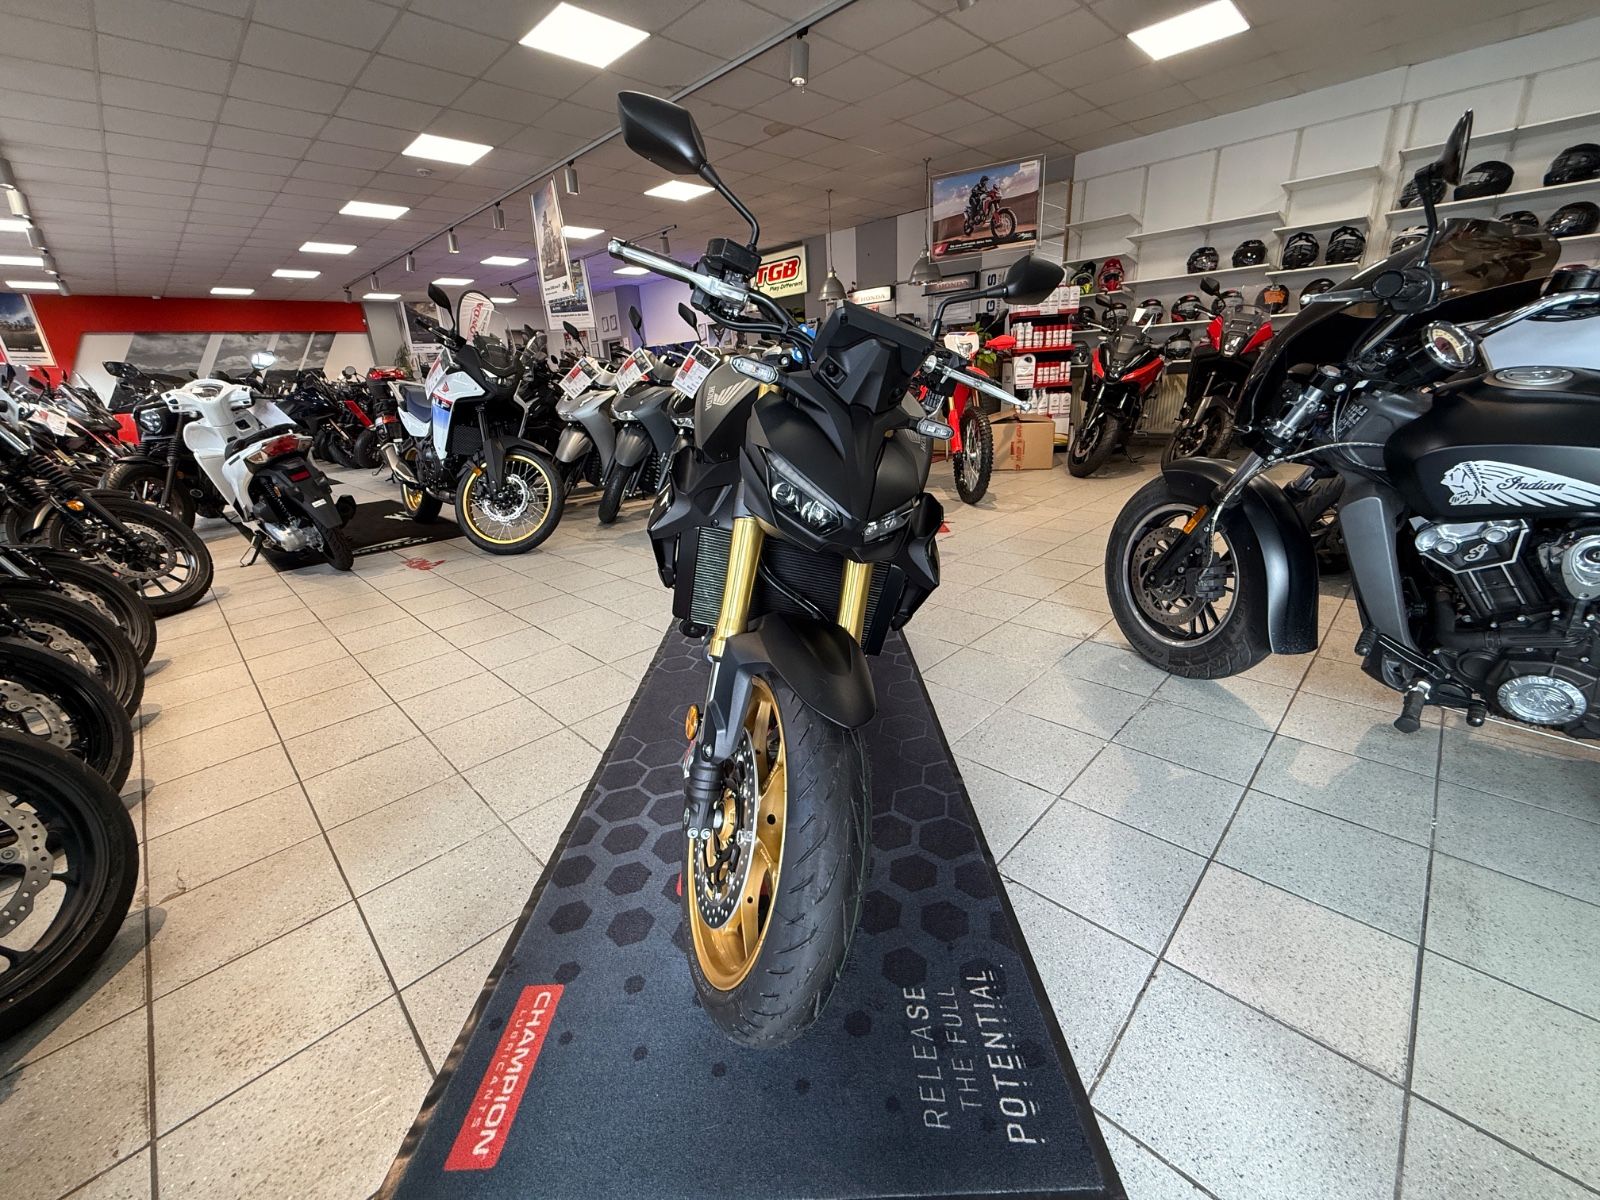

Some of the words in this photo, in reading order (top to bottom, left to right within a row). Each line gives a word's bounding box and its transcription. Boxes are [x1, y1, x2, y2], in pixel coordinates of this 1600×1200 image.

[757, 259, 799, 285] TGB
[860, 293, 886, 303] HONDA
[704, 385, 717, 412] HONDA
[1496, 475, 1567, 491] Indian
[937, 986, 968, 1045] FULL
[470, 1009, 528, 1129] LUBRICANTS
[471, 991, 552, 1156] CHAMPION
[903, 986, 951, 1130] RELEASE
[951, 1057, 983, 1112] THE
[965, 970, 1041, 1144] POTENTIAL
